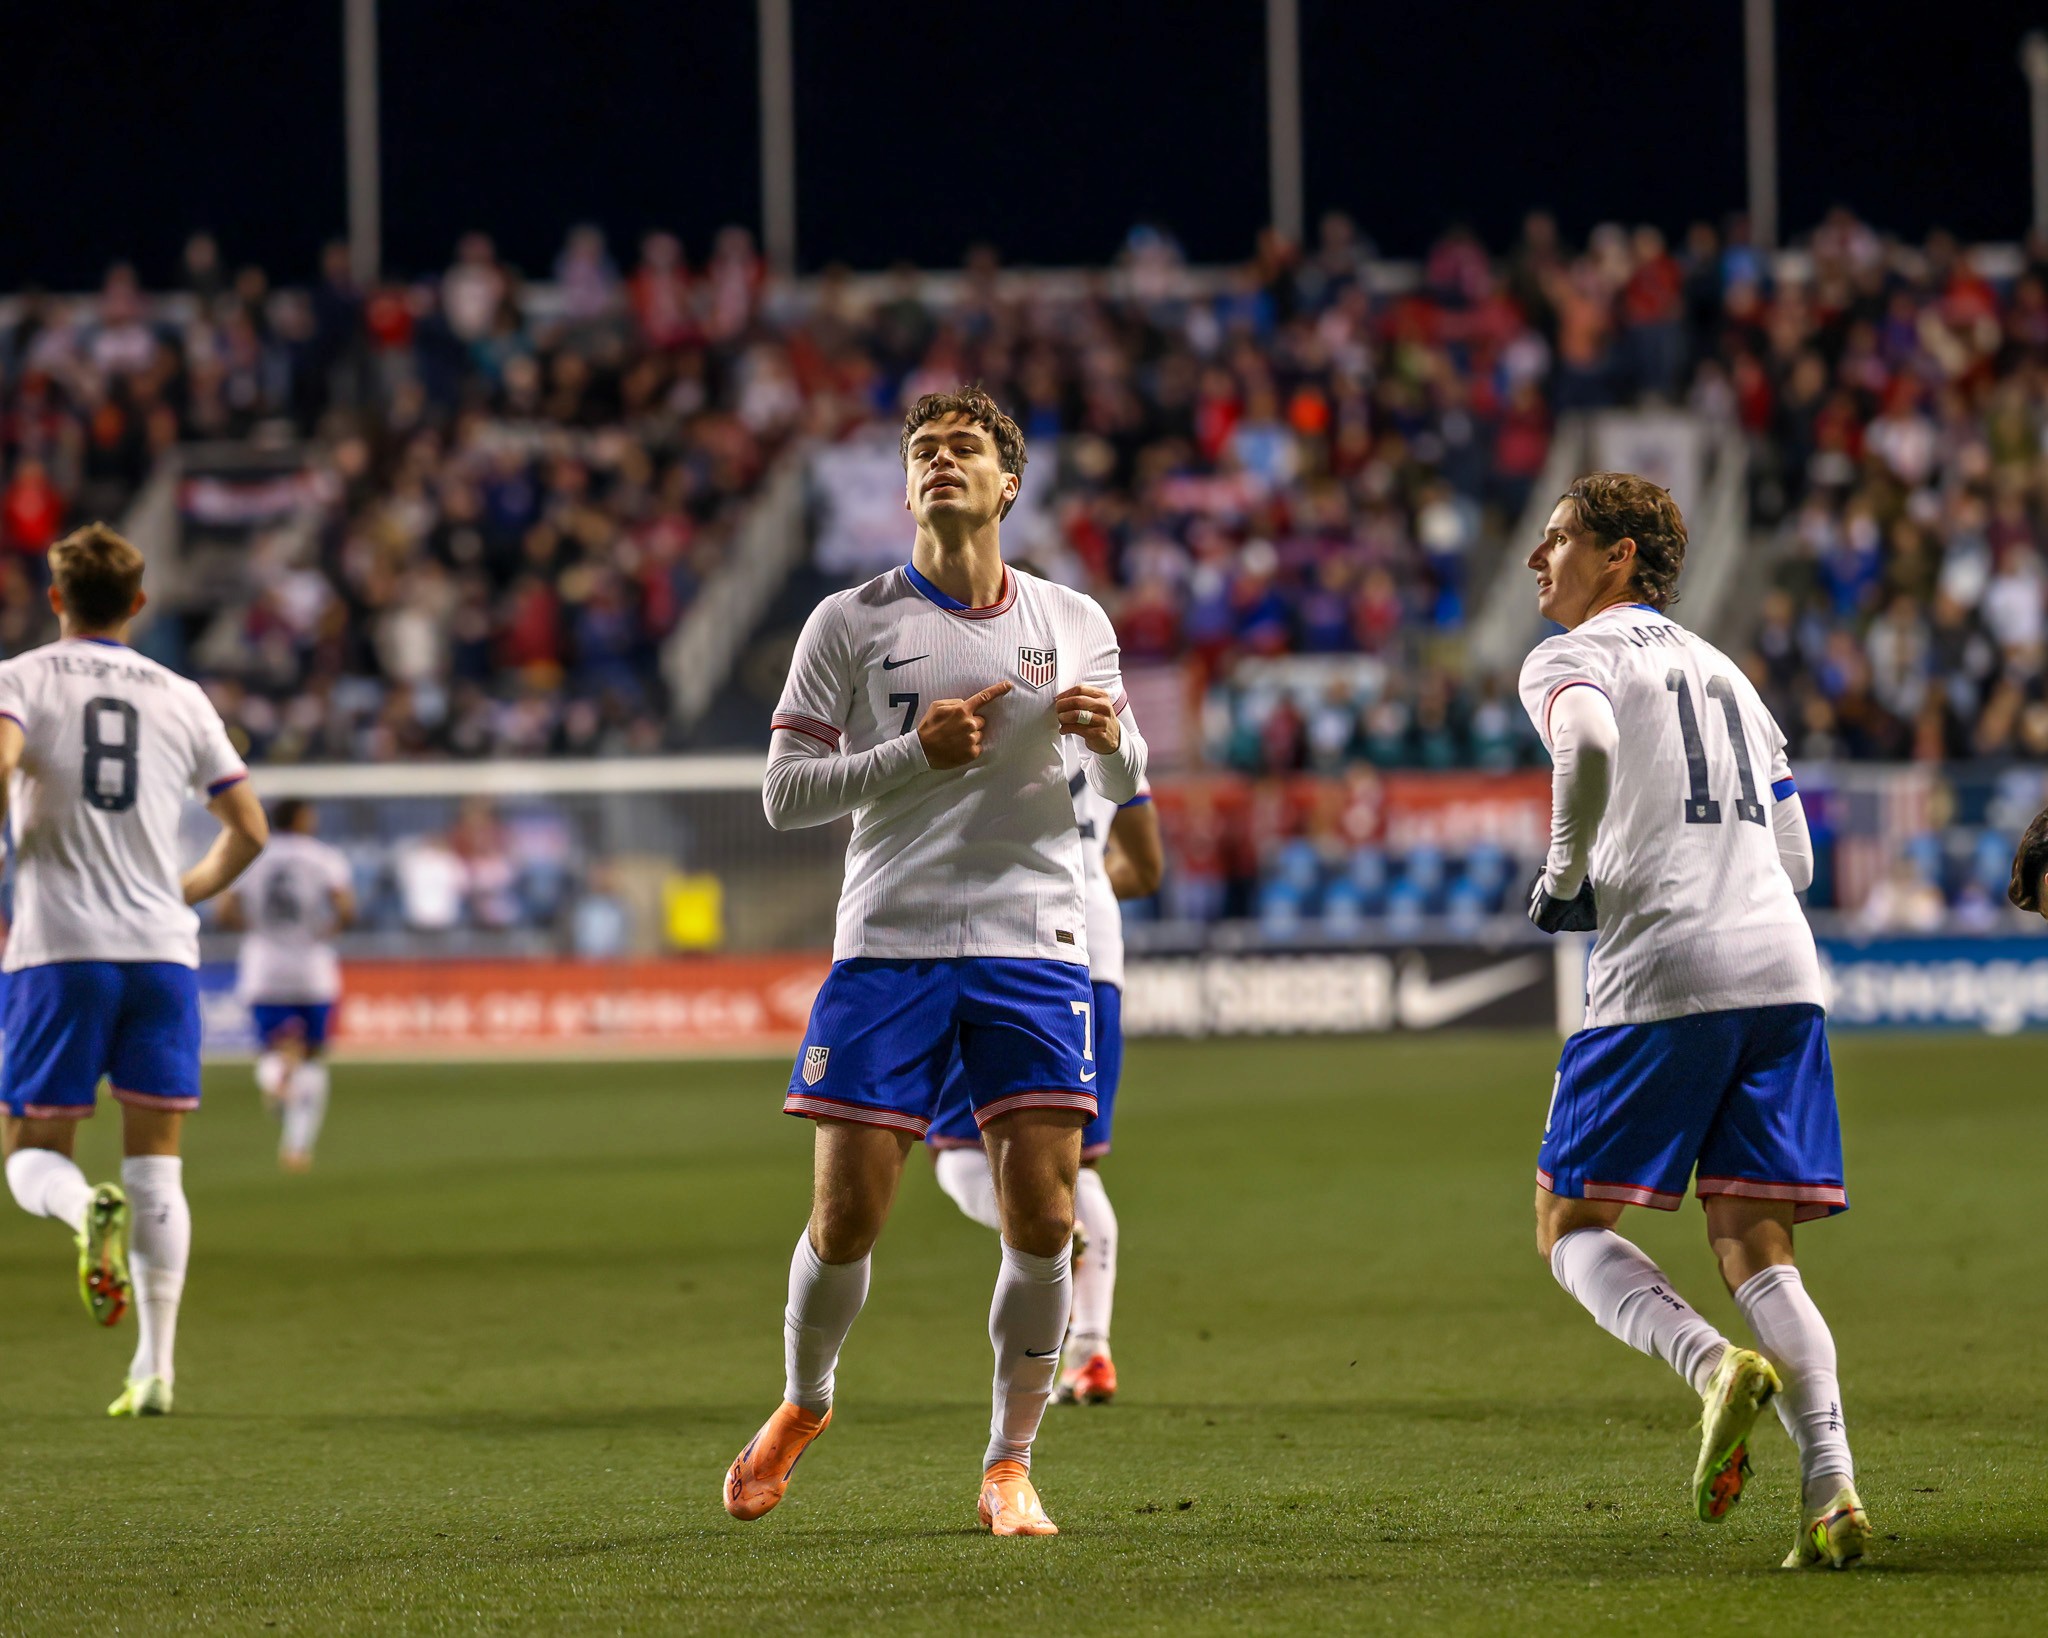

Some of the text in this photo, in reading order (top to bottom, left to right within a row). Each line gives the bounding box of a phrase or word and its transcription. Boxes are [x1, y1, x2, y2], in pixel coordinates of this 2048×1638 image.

[1022, 649, 1054, 665] USA
[889, 693, 919, 735] 7
[83, 697, 138, 813] 8
[1665, 668, 1766, 827] 11
[808, 1048, 828, 1063] USA
[1070, 1001, 1093, 1061] 7
